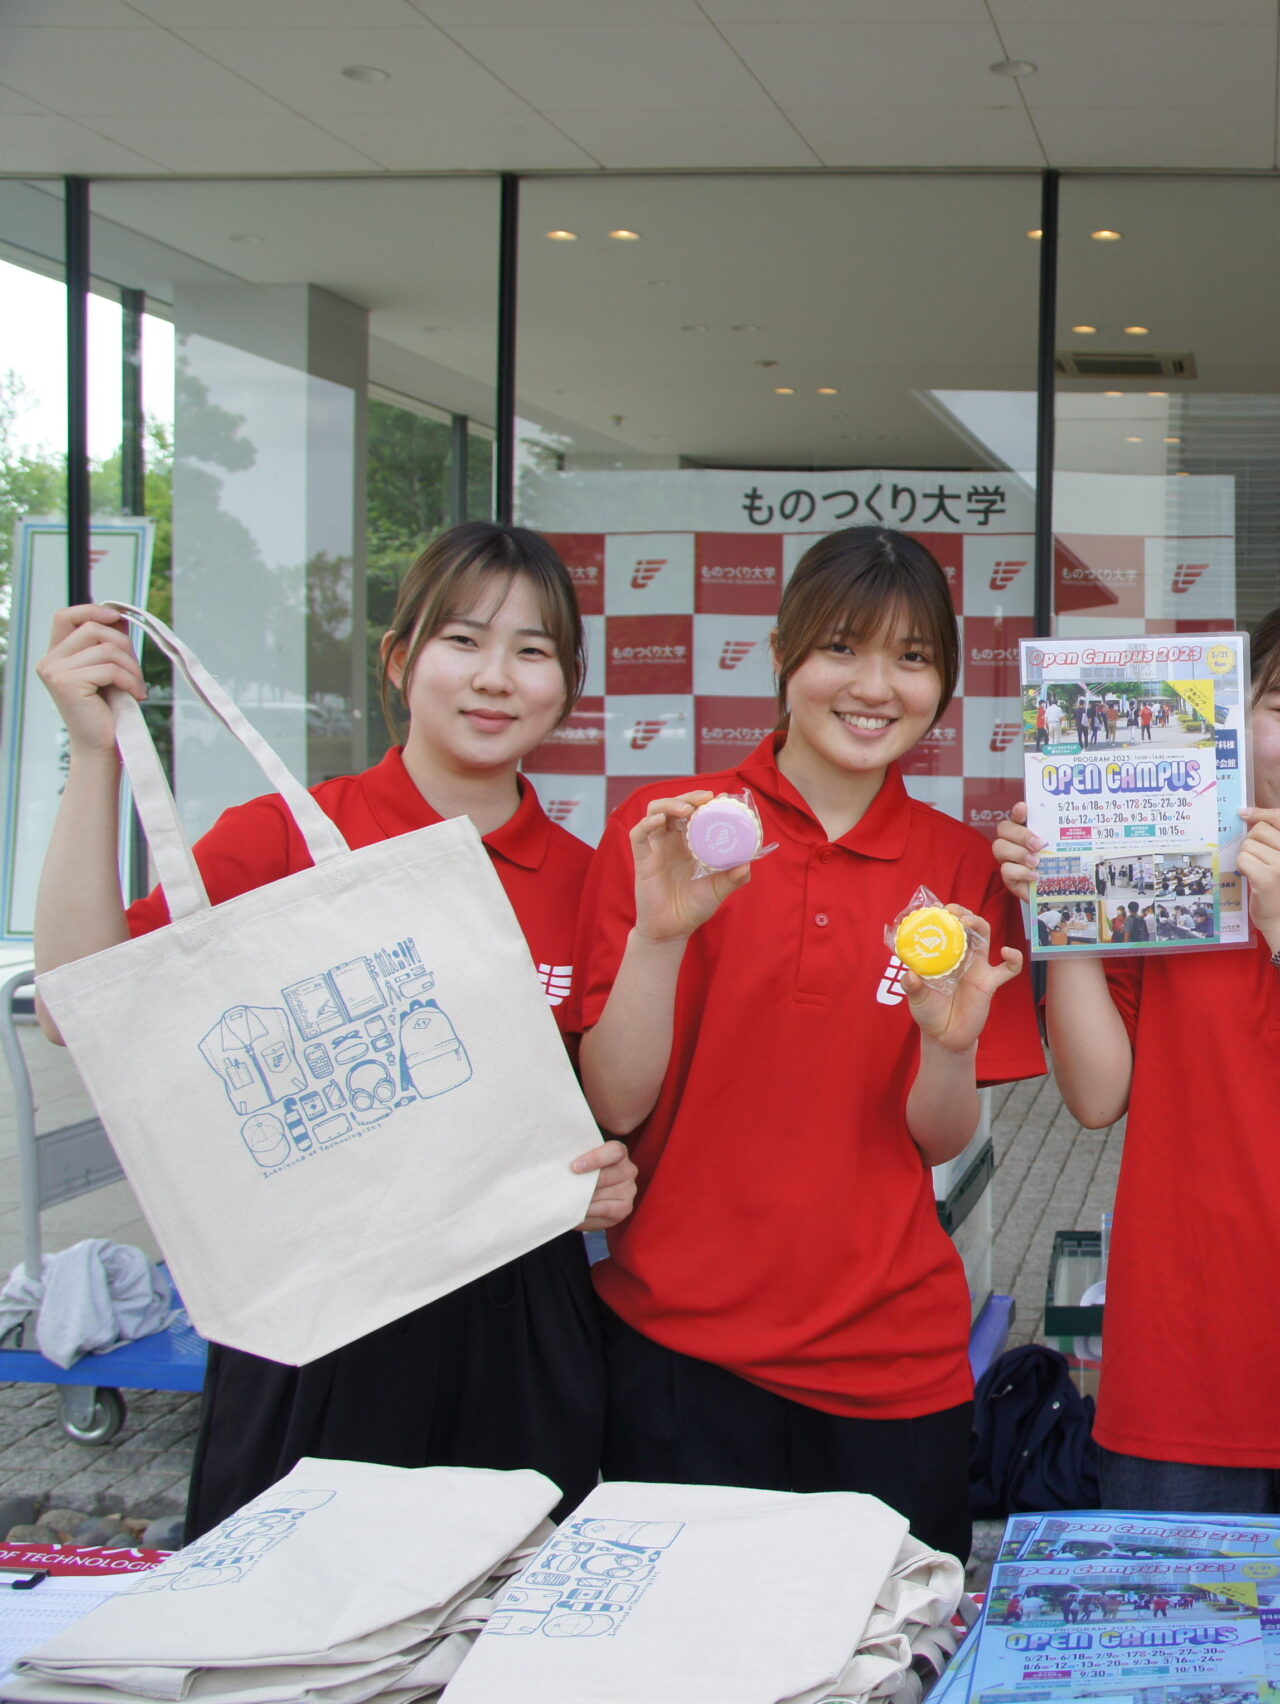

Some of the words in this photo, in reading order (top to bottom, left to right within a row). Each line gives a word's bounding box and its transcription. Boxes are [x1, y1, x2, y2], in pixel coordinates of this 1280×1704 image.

[742, 484, 1006, 525] ものつくり大学
[702, 565, 776, 579] ものつくり大学
[1062, 567, 1138, 581] ものつくり大学
[612, 646, 686, 659] ものつくり大学
[971, 649, 1020, 661] ものつくり
[1030, 650, 1079, 668] Open
[1082, 649, 1154, 667] Campus
[1156, 646, 1203, 662] 2023
[1042, 763, 1101, 795] OPEN
[1105, 760, 1201, 794] CAMPUS
[1051, 1520, 1111, 1534] Open
[1114, 1524, 1207, 1538] Campus
[1208, 1531, 1270, 1543] 2023
[1002, 1564, 1069, 1578] Open
[1072, 1562, 1171, 1577] Campus
[1173, 1563, 1236, 1573] 2023
[1005, 1631, 1092, 1651] OPEN
[1099, 1625, 1239, 1649] CAMPUS
